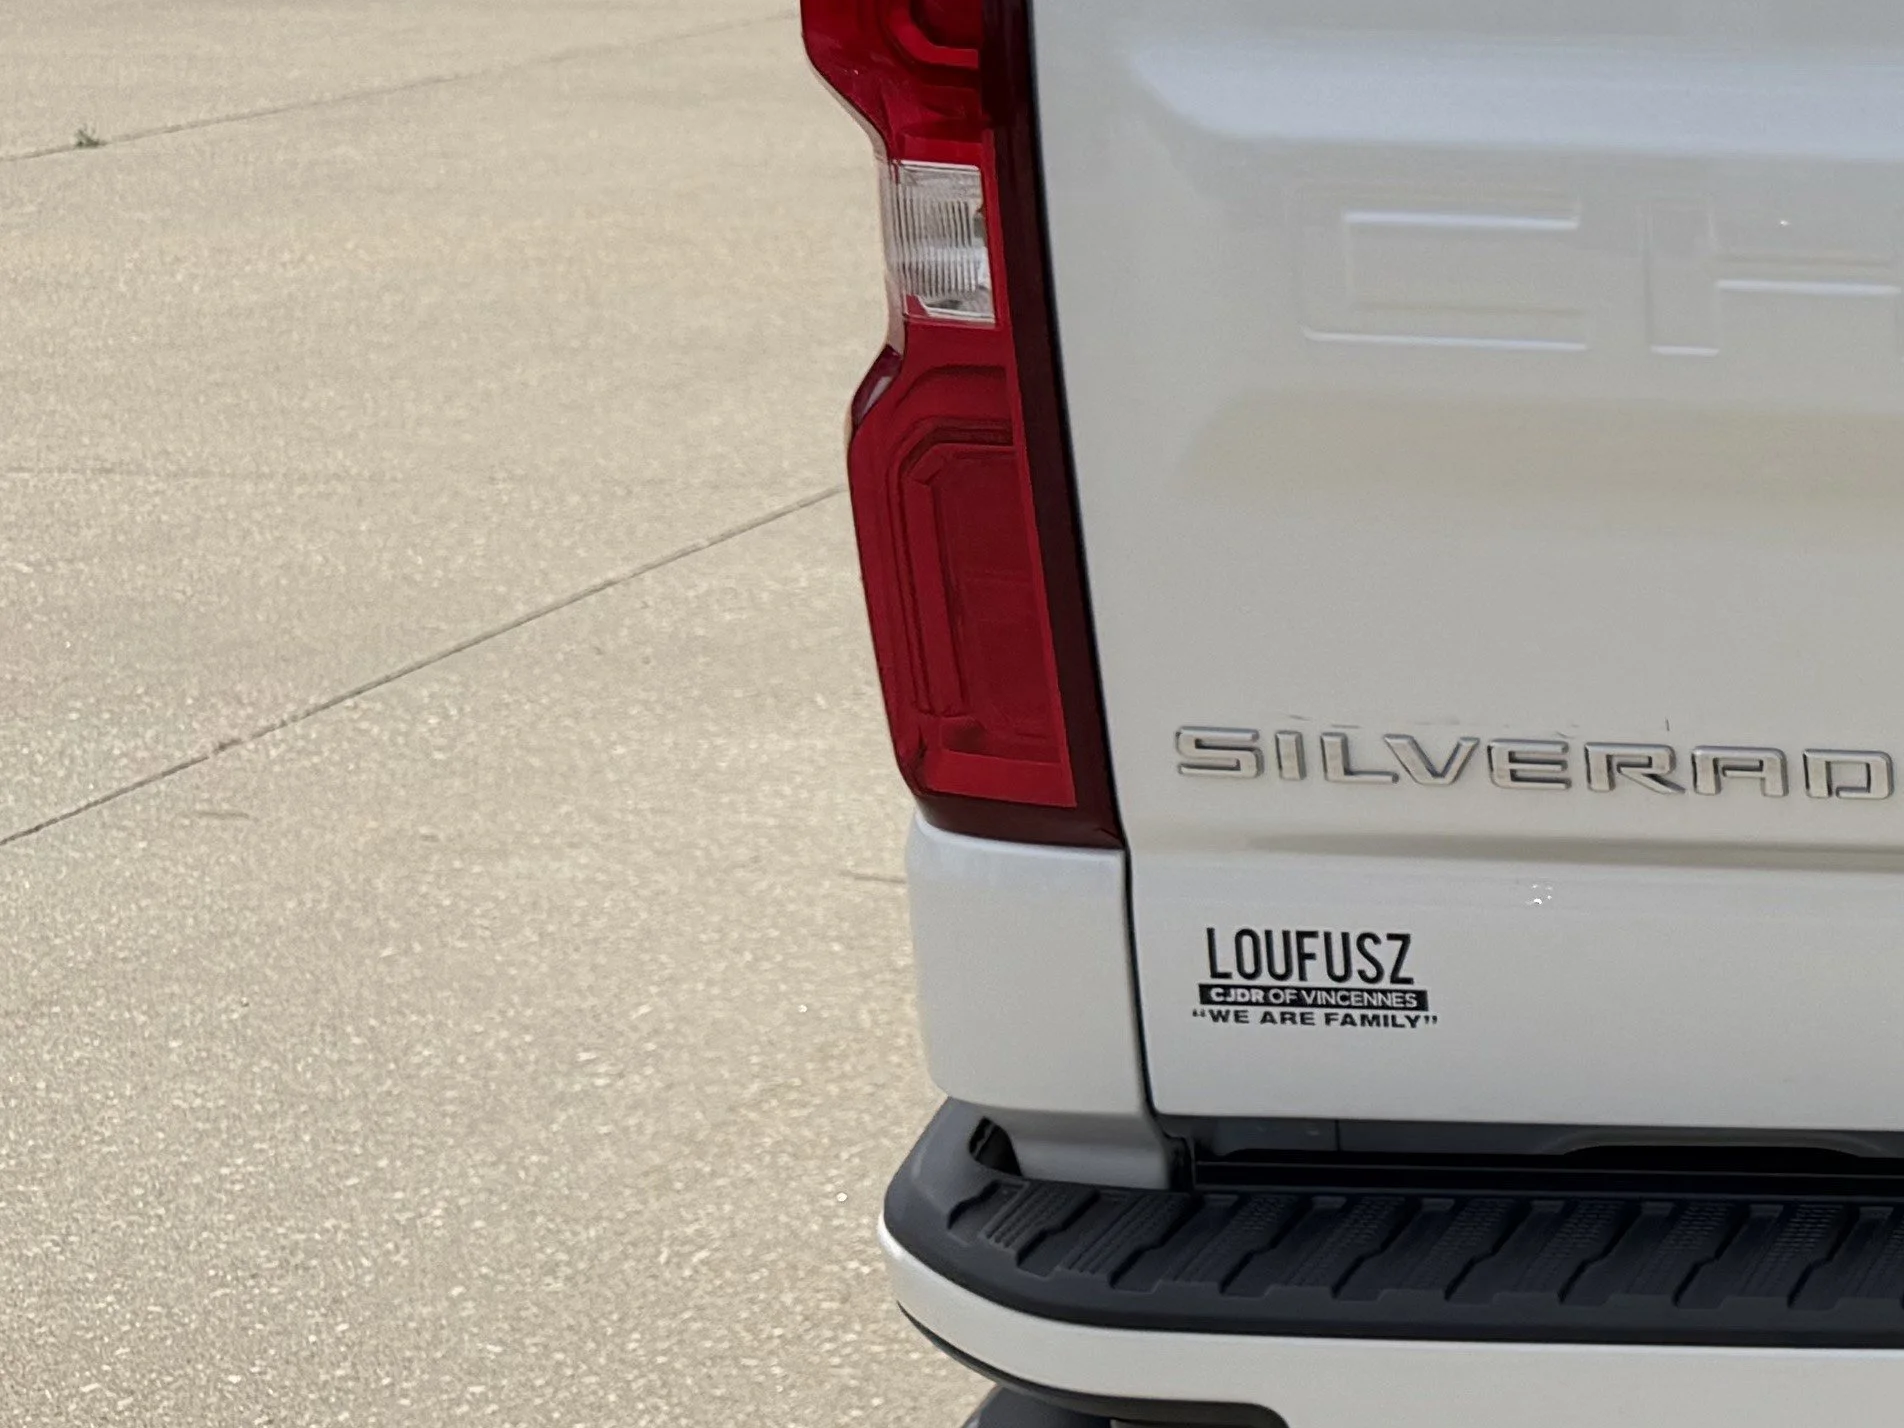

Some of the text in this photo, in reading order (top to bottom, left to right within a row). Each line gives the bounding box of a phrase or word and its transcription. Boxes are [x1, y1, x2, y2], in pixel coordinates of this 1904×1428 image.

[1209, 987, 1418, 1008] CJDR OF VINCENNES
[1259, 1009, 1316, 1026] ARE
